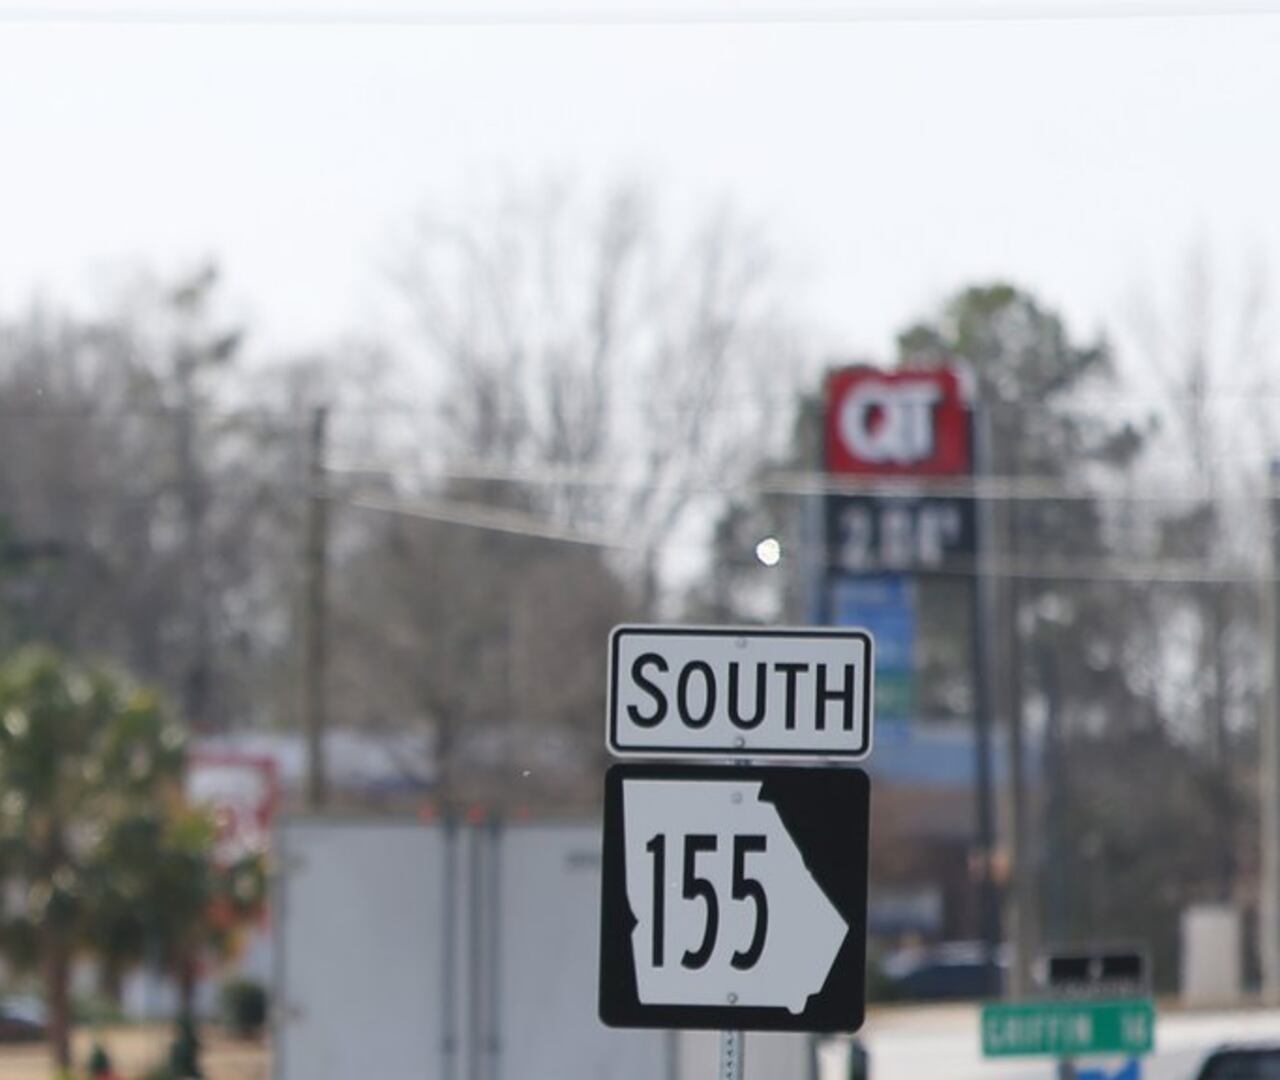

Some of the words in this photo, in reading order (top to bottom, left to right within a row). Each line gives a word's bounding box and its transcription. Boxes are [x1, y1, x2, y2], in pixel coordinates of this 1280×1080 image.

[839, 378, 943, 463] QT
[626, 652, 854, 731] SOUTH
[646, 833, 768, 970] 155
